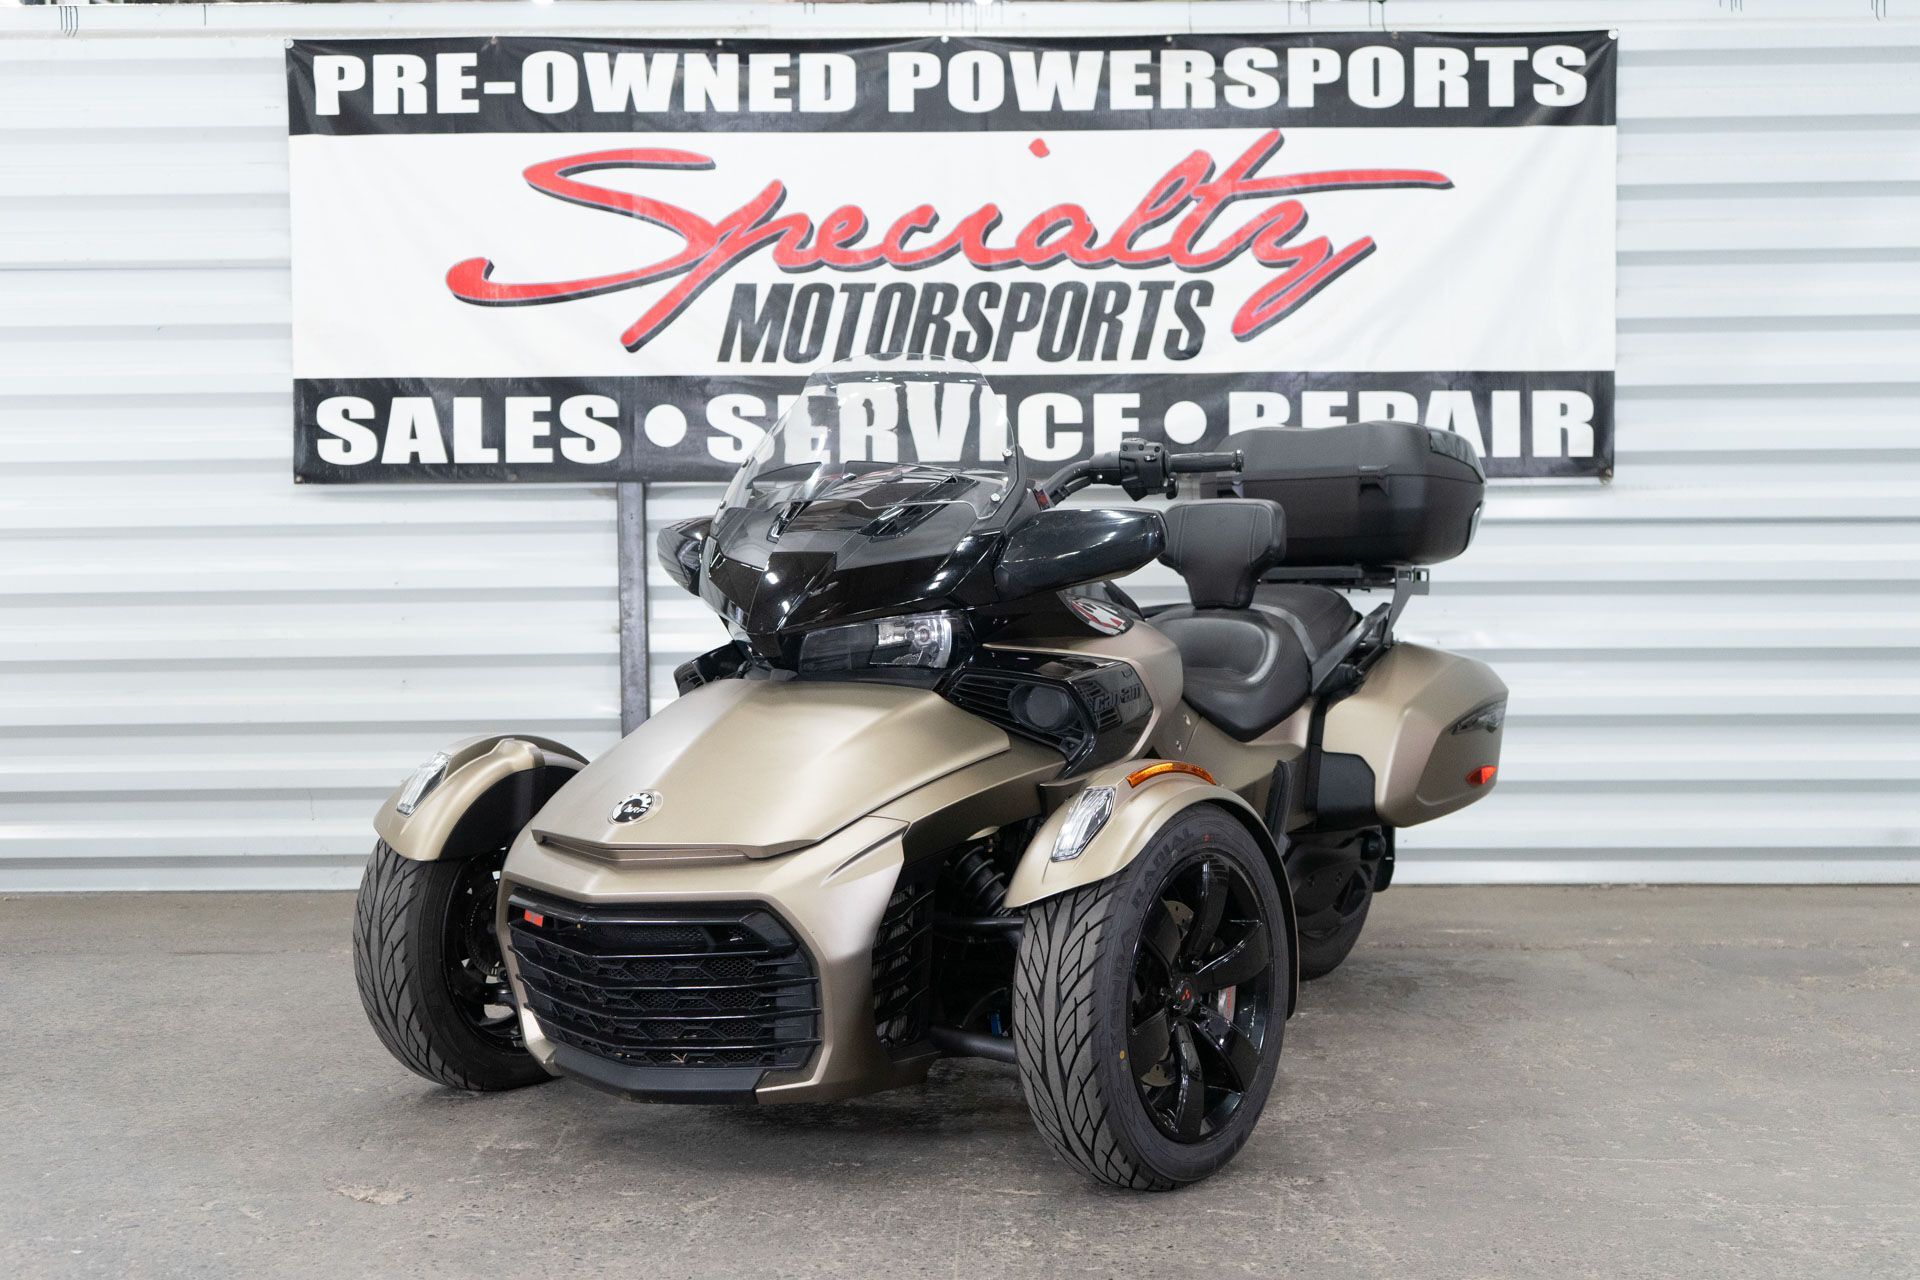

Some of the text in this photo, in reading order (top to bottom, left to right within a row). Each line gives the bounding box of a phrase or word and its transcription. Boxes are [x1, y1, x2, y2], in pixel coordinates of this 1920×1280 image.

[314, 45, 1588, 115] PRE-OWNED POWERSPORTS
[445, 128, 1455, 353] Specialty
[716, 279, 1213, 363] MOTORSPORTS
[316, 394, 621, 465] SALES
[706, 382, 1140, 463] SERVICE
